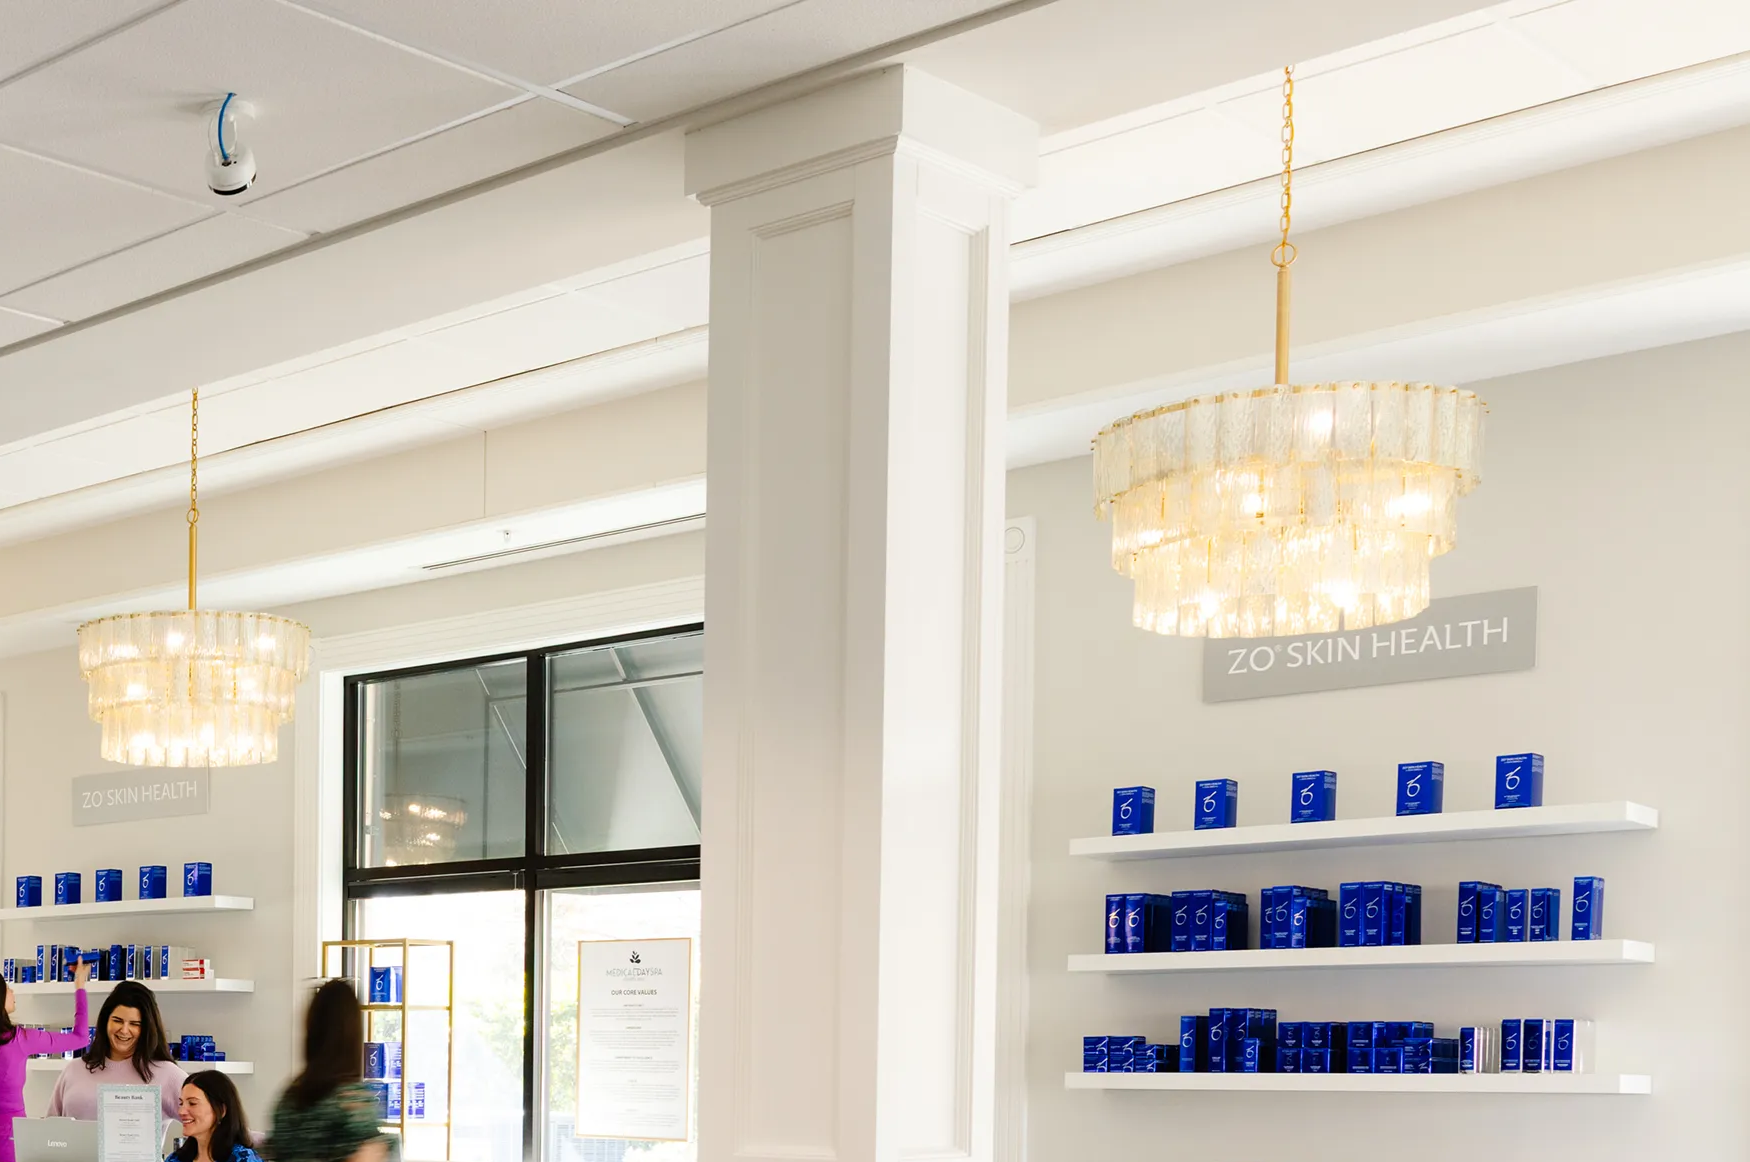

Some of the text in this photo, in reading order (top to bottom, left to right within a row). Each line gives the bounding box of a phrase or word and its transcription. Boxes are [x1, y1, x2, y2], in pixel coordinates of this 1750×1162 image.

[1286, 635, 1360, 668] SKIN
[1371, 616, 1509, 658] HEALTH
[107, 786, 138, 806] SKIN
[142, 780, 197, 802] HEALTH
[47, 1139, 68, 1148] Lenovo
